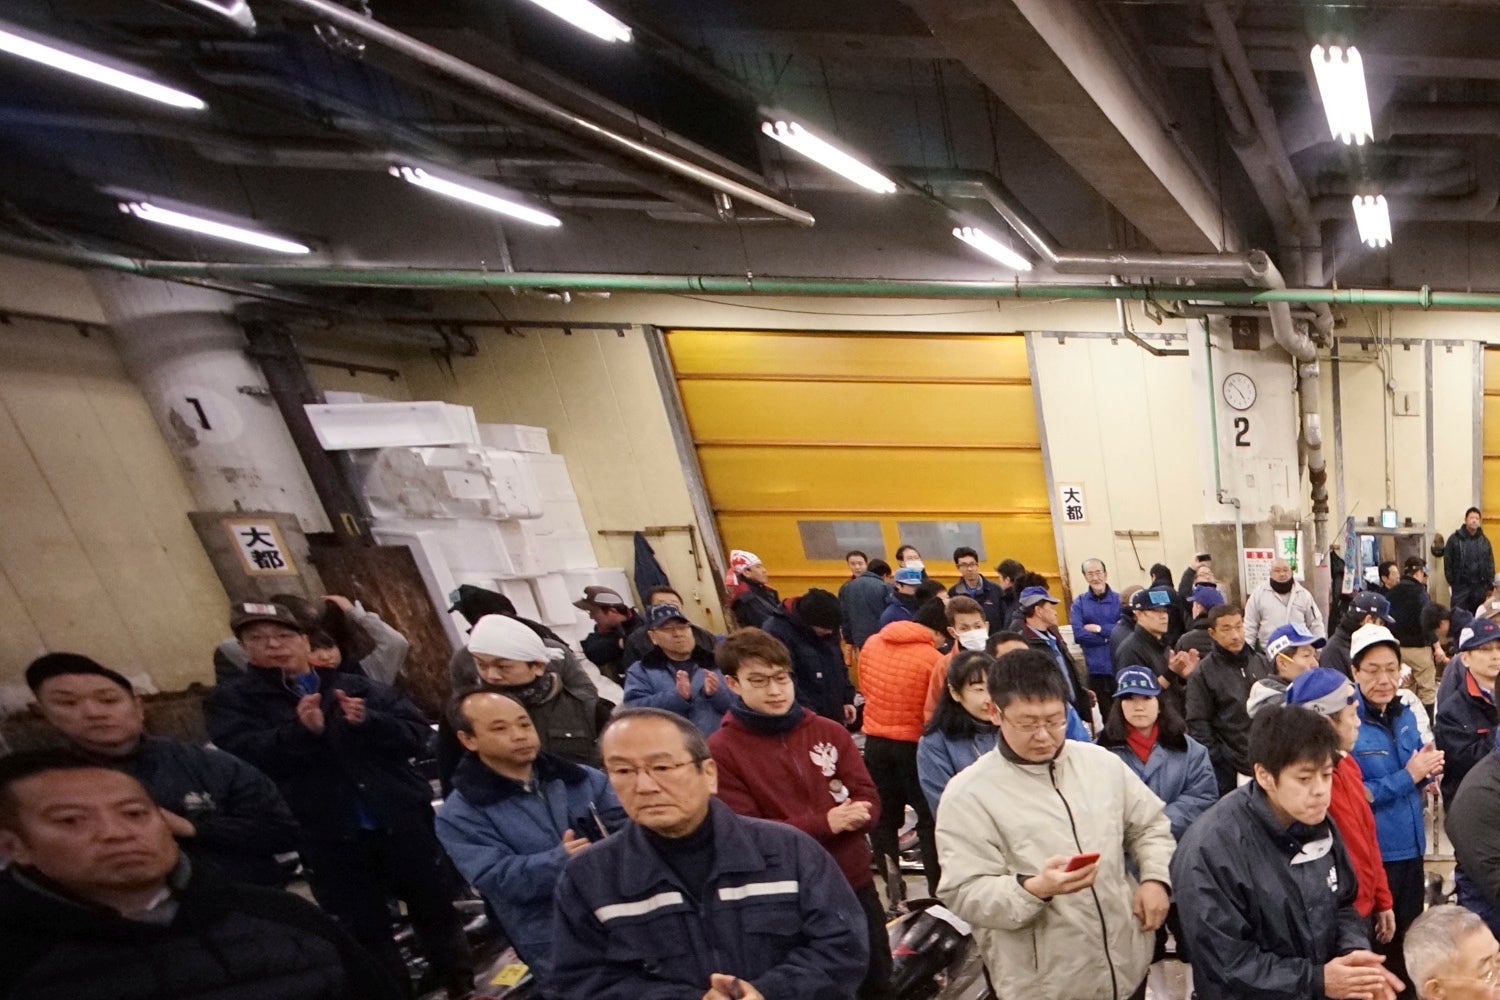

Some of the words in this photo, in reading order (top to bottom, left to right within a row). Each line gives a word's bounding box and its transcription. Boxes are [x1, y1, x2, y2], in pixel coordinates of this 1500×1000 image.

[186, 397, 212, 430] 1
[1234, 417, 1251, 447] 2
[1063, 487, 1083, 520] 大都
[241, 527, 285, 569] 大都
